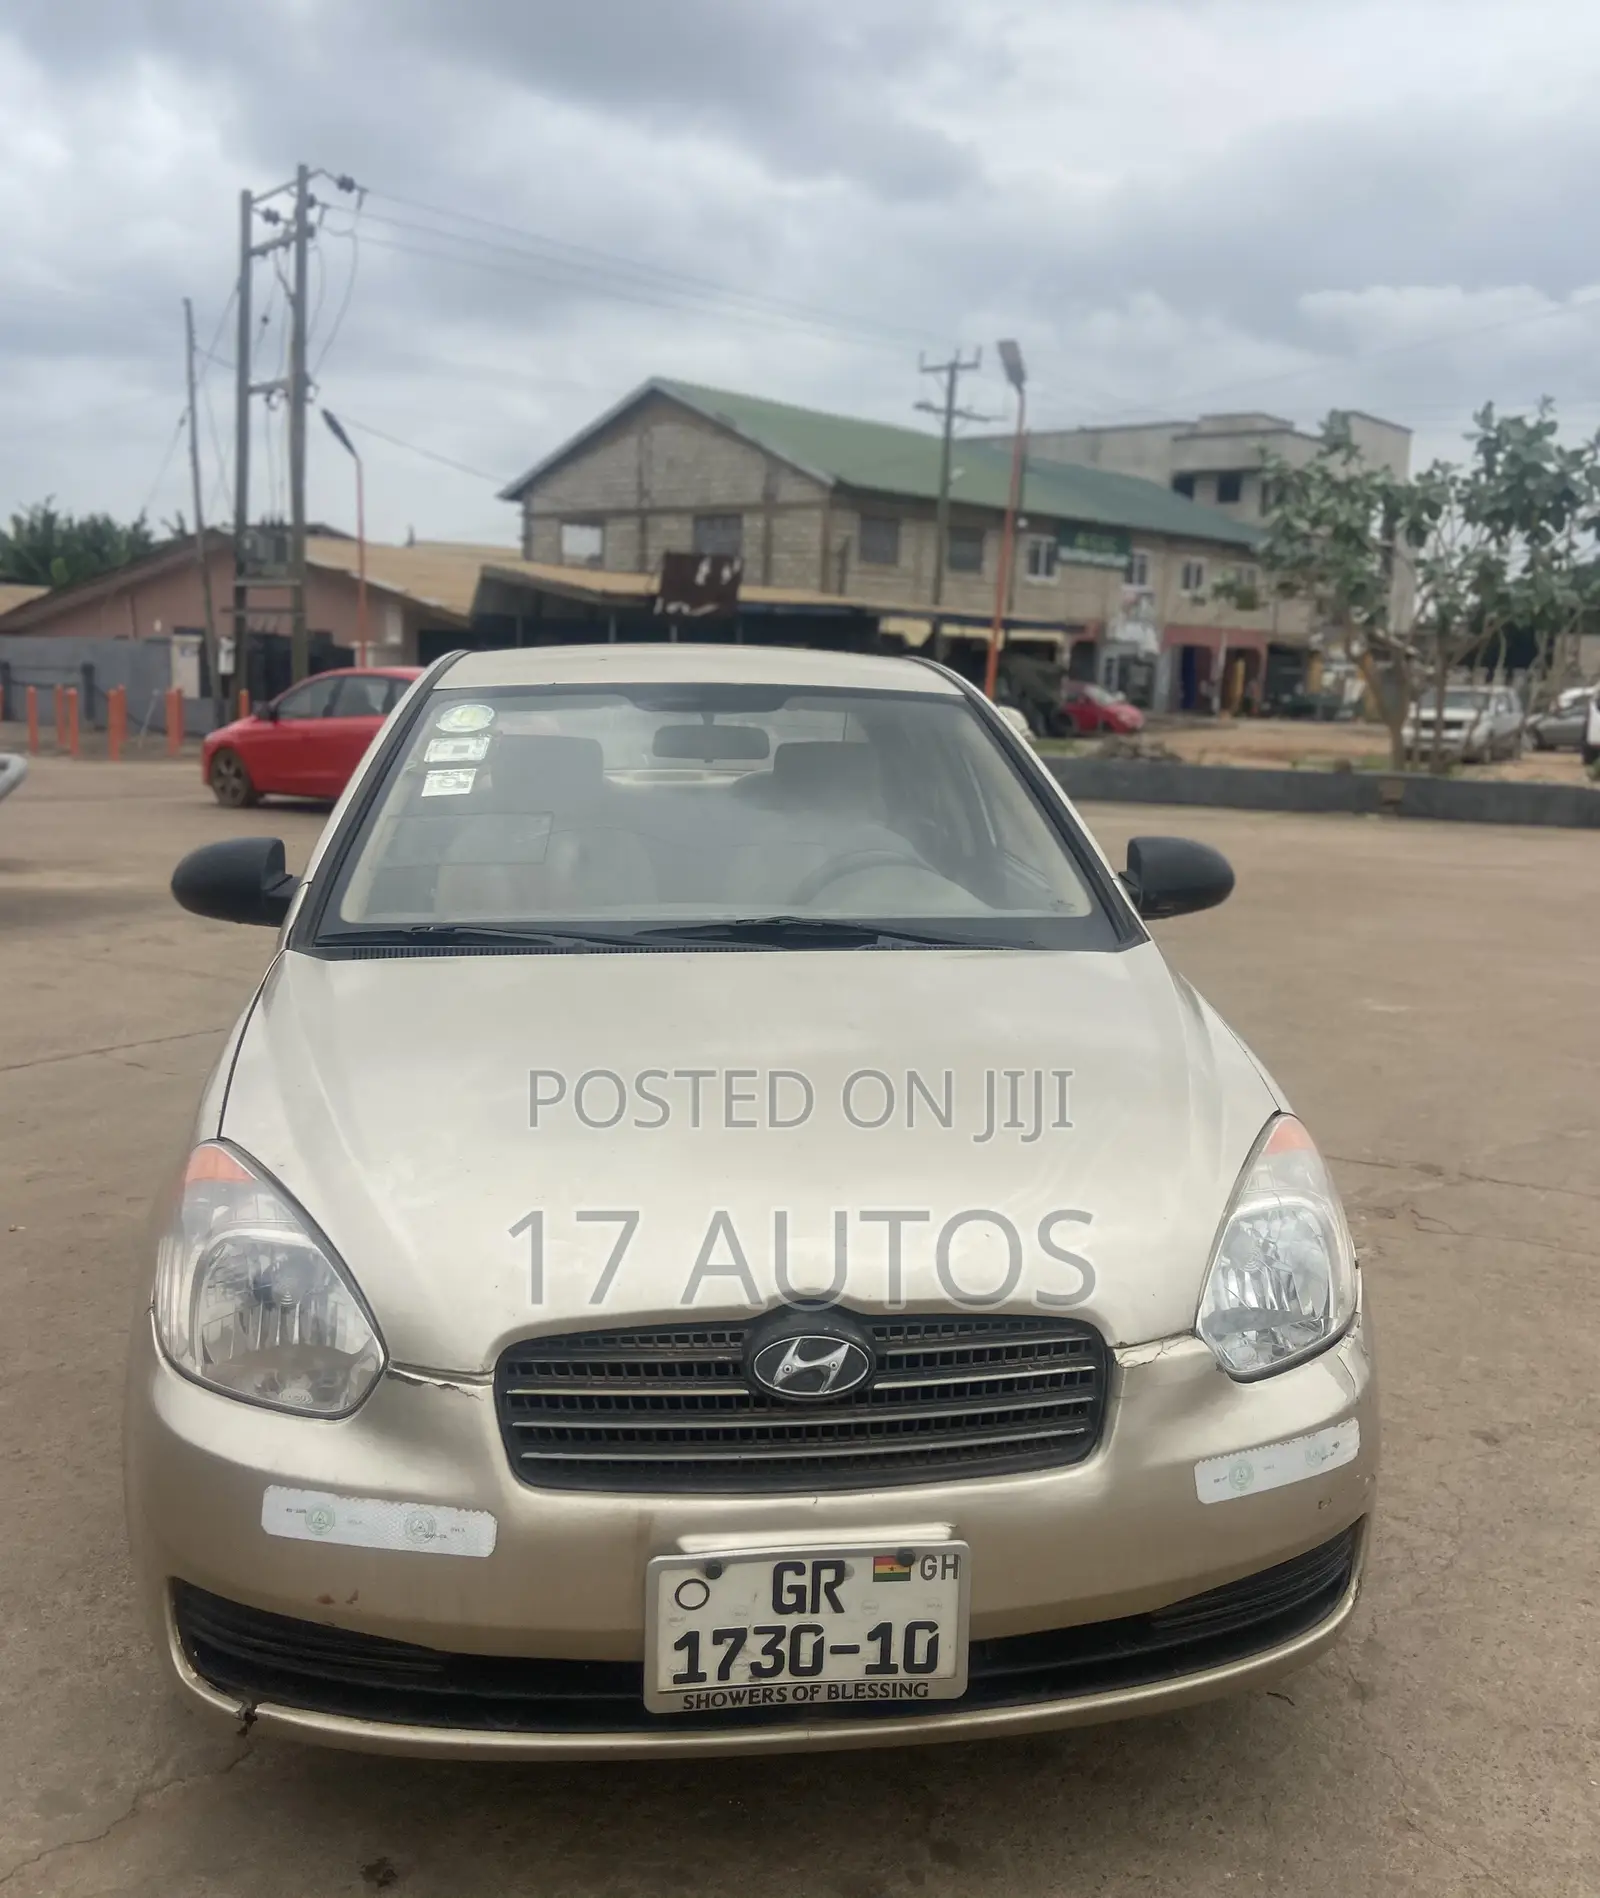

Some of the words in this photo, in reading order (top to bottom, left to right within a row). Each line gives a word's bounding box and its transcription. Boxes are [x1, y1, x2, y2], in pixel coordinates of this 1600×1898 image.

[772, 1559, 846, 1615] GR
[919, 1553, 961, 1581] GH
[672, 1620, 940, 1685] 1730-10
[683, 1686, 788, 1711] SHOWERS
[792, 1684, 822, 1702] OF
[827, 1682, 929, 1701] BLESSING
